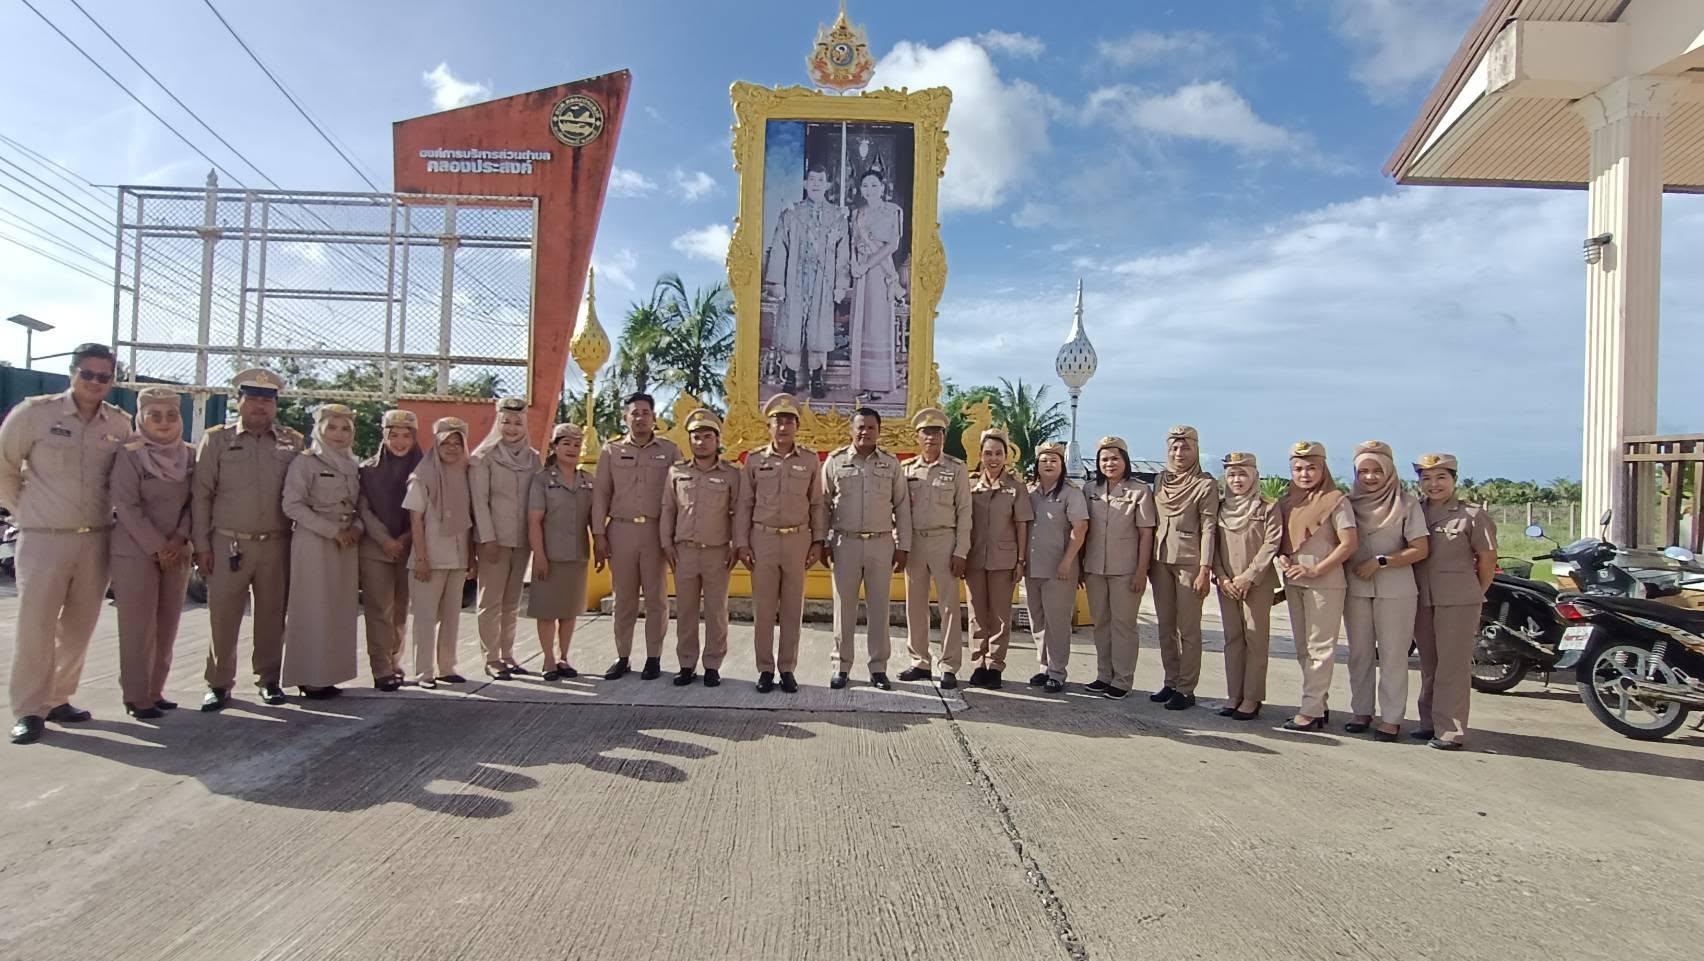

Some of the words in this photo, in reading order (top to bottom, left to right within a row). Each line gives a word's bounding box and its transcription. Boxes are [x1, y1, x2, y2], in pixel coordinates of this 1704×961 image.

[427, 160, 533, 174] คลองประสงค์
